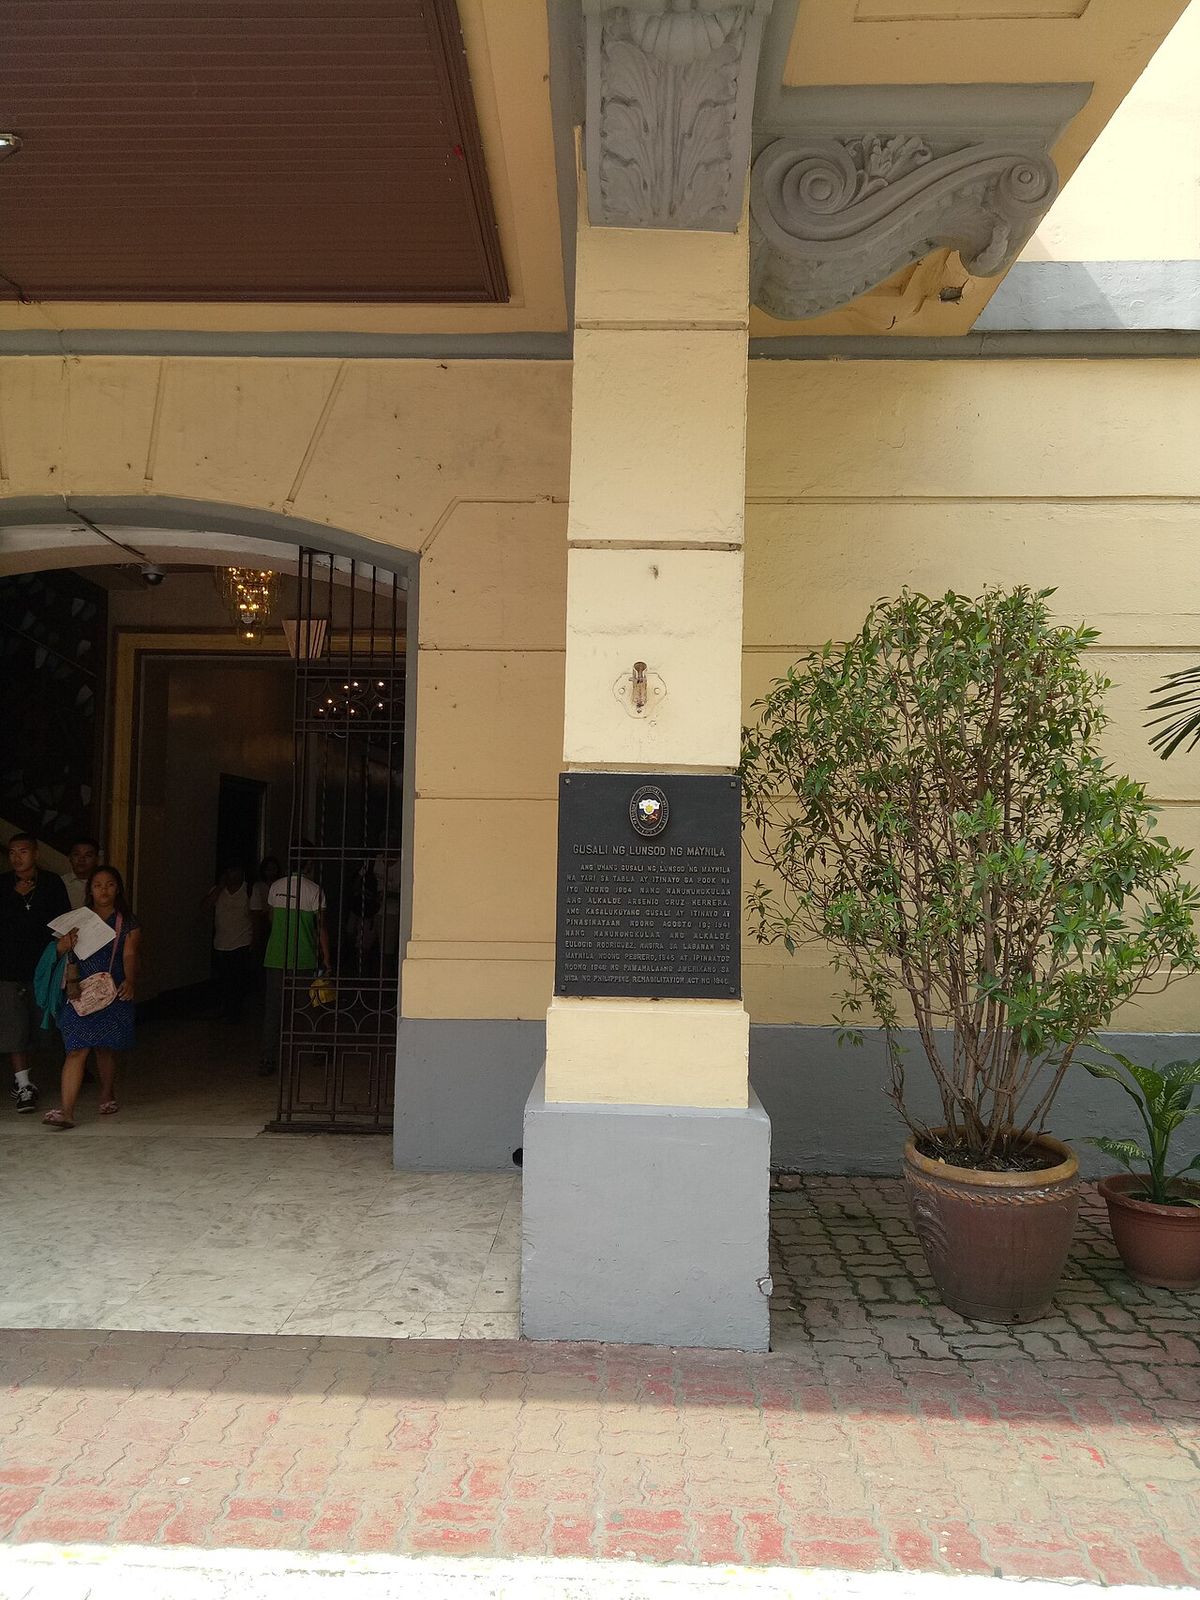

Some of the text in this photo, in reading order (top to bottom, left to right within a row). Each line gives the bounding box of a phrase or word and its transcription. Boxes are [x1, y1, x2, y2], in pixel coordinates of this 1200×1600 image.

[573, 844, 726, 857] GUSALI NG LUNSOD NG MAYNILA
